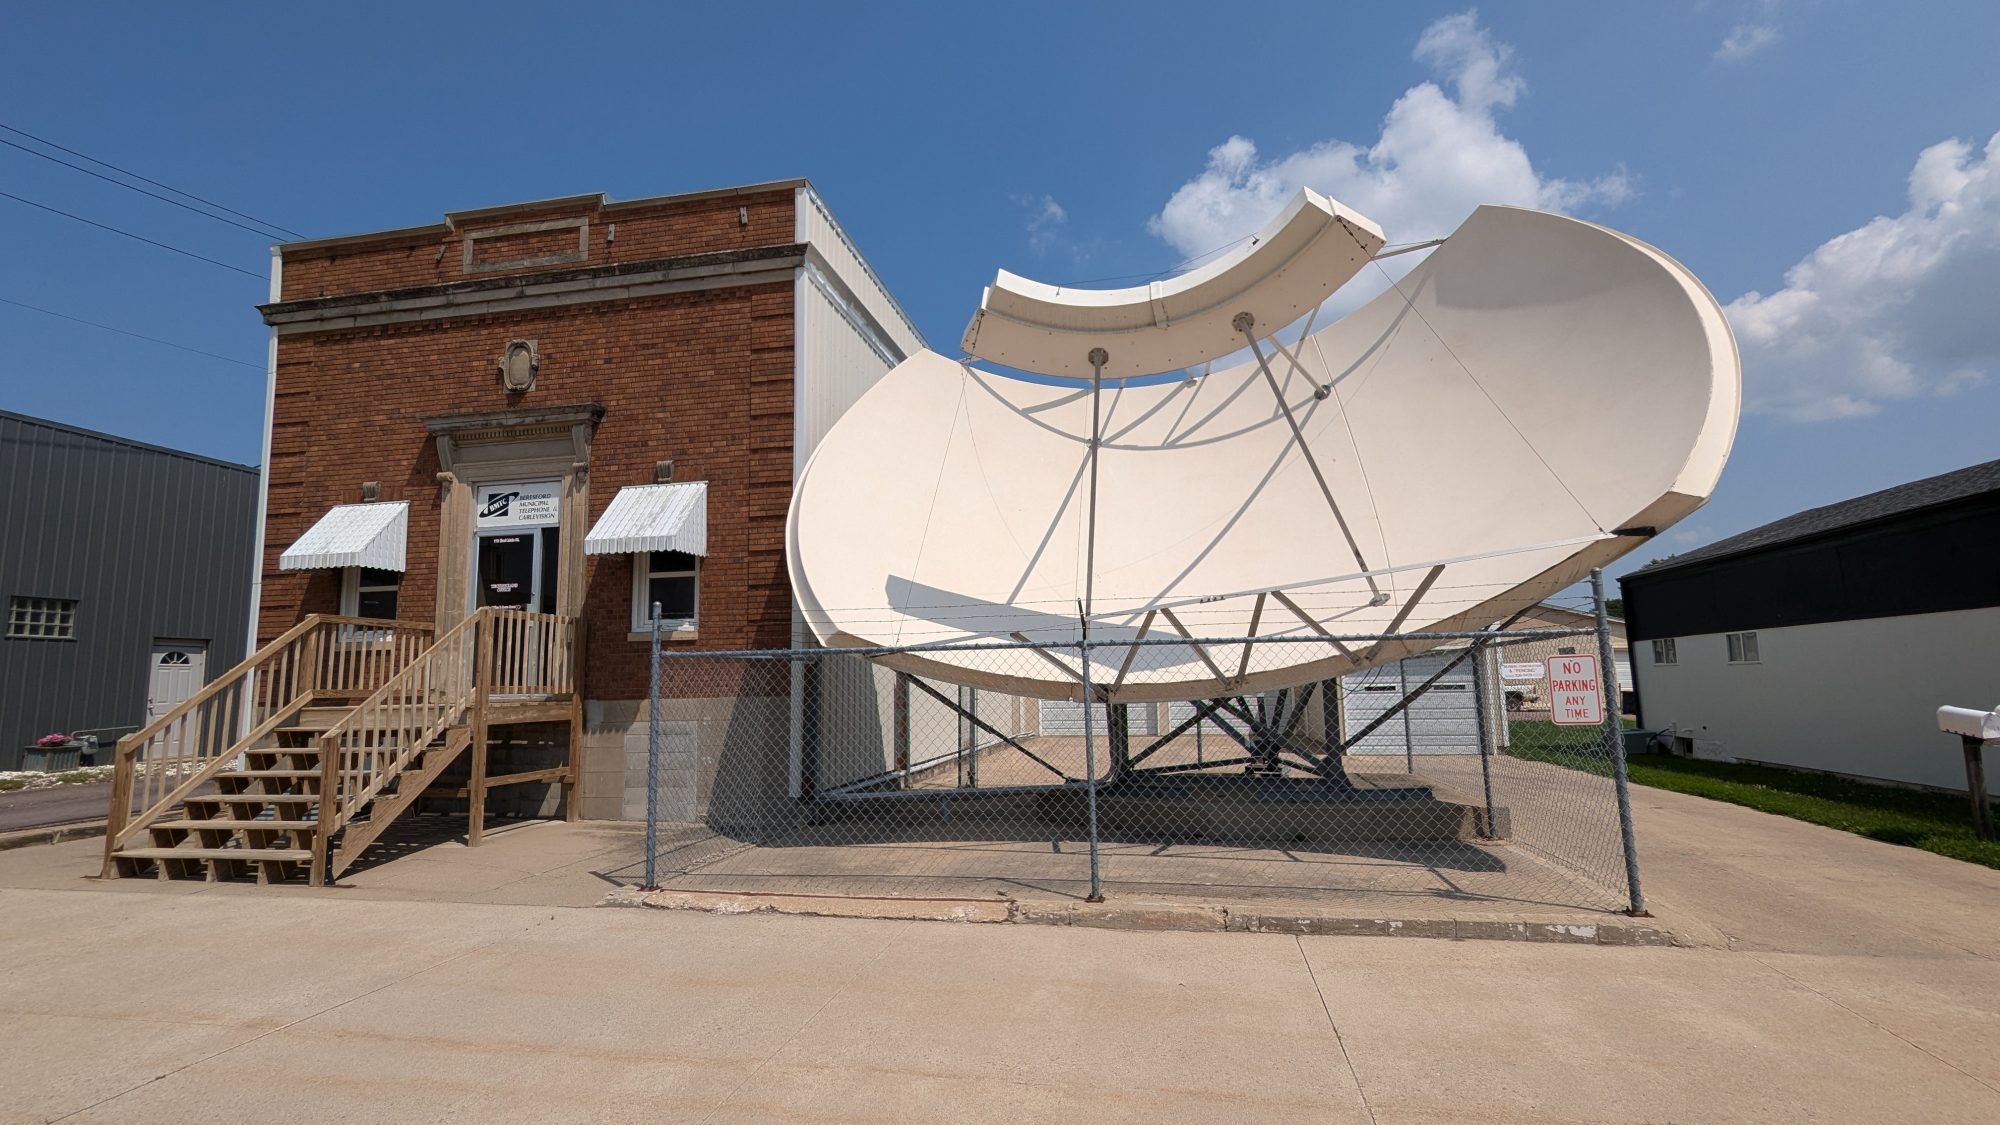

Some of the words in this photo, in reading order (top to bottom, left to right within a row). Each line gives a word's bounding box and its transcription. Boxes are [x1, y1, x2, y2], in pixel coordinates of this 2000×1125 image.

[519, 493, 552, 501] BERESFORD
[489, 497, 508, 512] BMTC
[519, 500, 549, 508] MUNICIPAL
[519, 506, 550, 514] TELEPHONE
[518, 513, 556, 521] CABLEVISION
[1562, 661, 1582, 674] NO
[1552, 679, 1596, 692] PARKING
[1565, 695, 1586, 706] ANY
[1564, 708, 1590, 719] TIME
